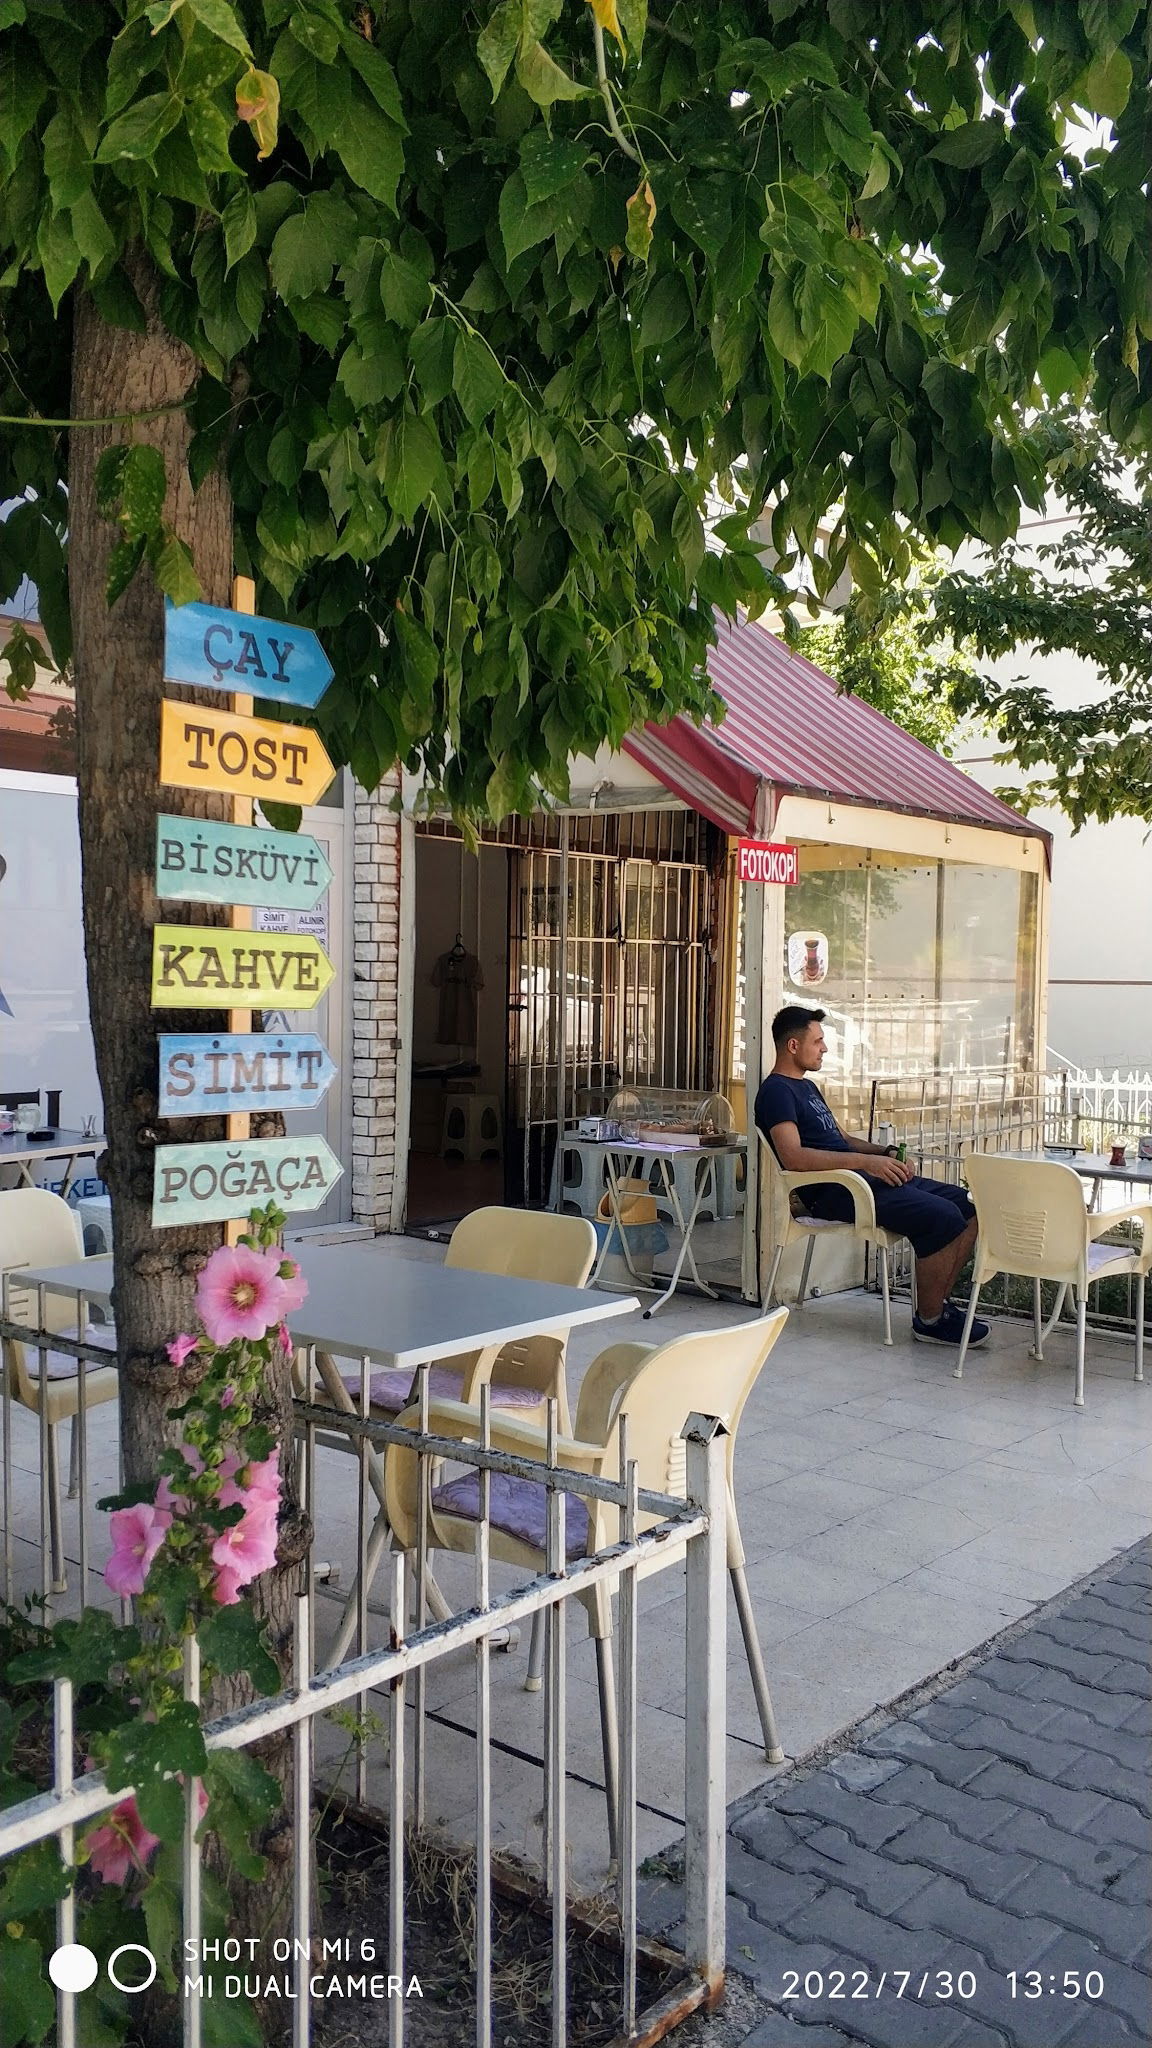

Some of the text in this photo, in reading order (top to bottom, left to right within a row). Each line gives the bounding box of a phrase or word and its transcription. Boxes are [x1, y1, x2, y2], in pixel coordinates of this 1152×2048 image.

[204, 625, 294, 682] ÇAY
[184, 725, 308, 785] TOST
[161, 834, 319, 886] BİSKÜVİ
[741, 848, 797, 883] FOTOKOPİ
[158, 944, 319, 990] KAHVE
[167, 1040, 322, 1096] SİMİT
[161, 1150, 327, 1203] POĞAÇA
